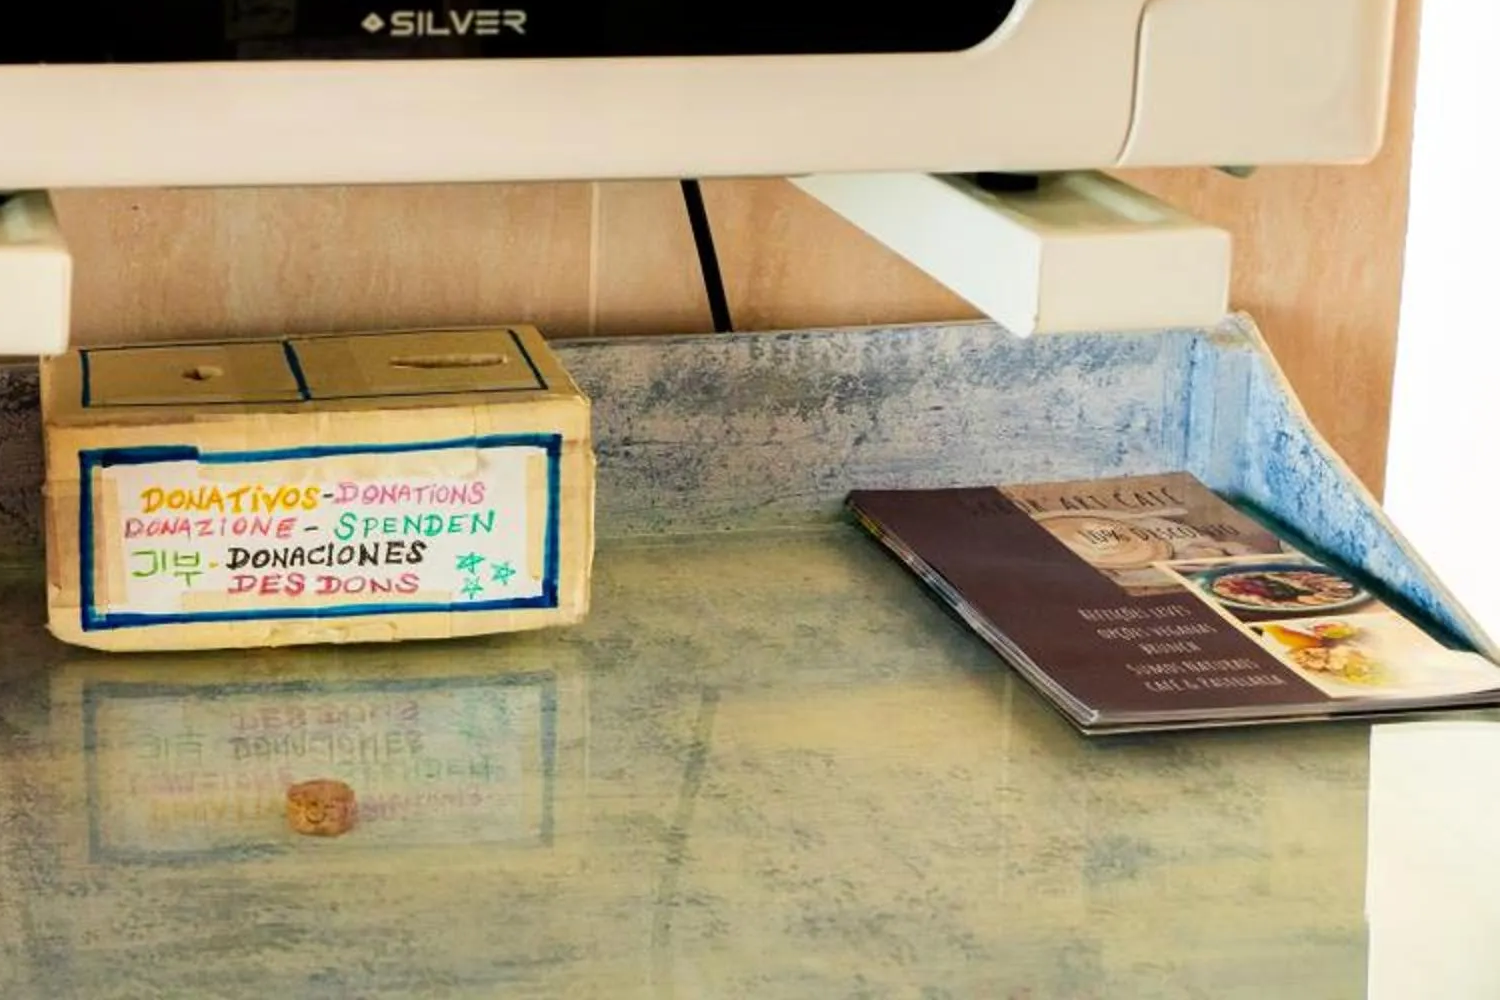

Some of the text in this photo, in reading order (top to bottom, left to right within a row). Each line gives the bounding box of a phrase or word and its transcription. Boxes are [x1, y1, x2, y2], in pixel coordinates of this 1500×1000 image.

[389, 9, 528, 37] SILVER
[124, 515, 298, 541] DONAZIONE
[333, 508, 496, 541] SPENDEN
[225, 539, 428, 570] DONACIONES
[226, 572, 421, 596] DES DONS
